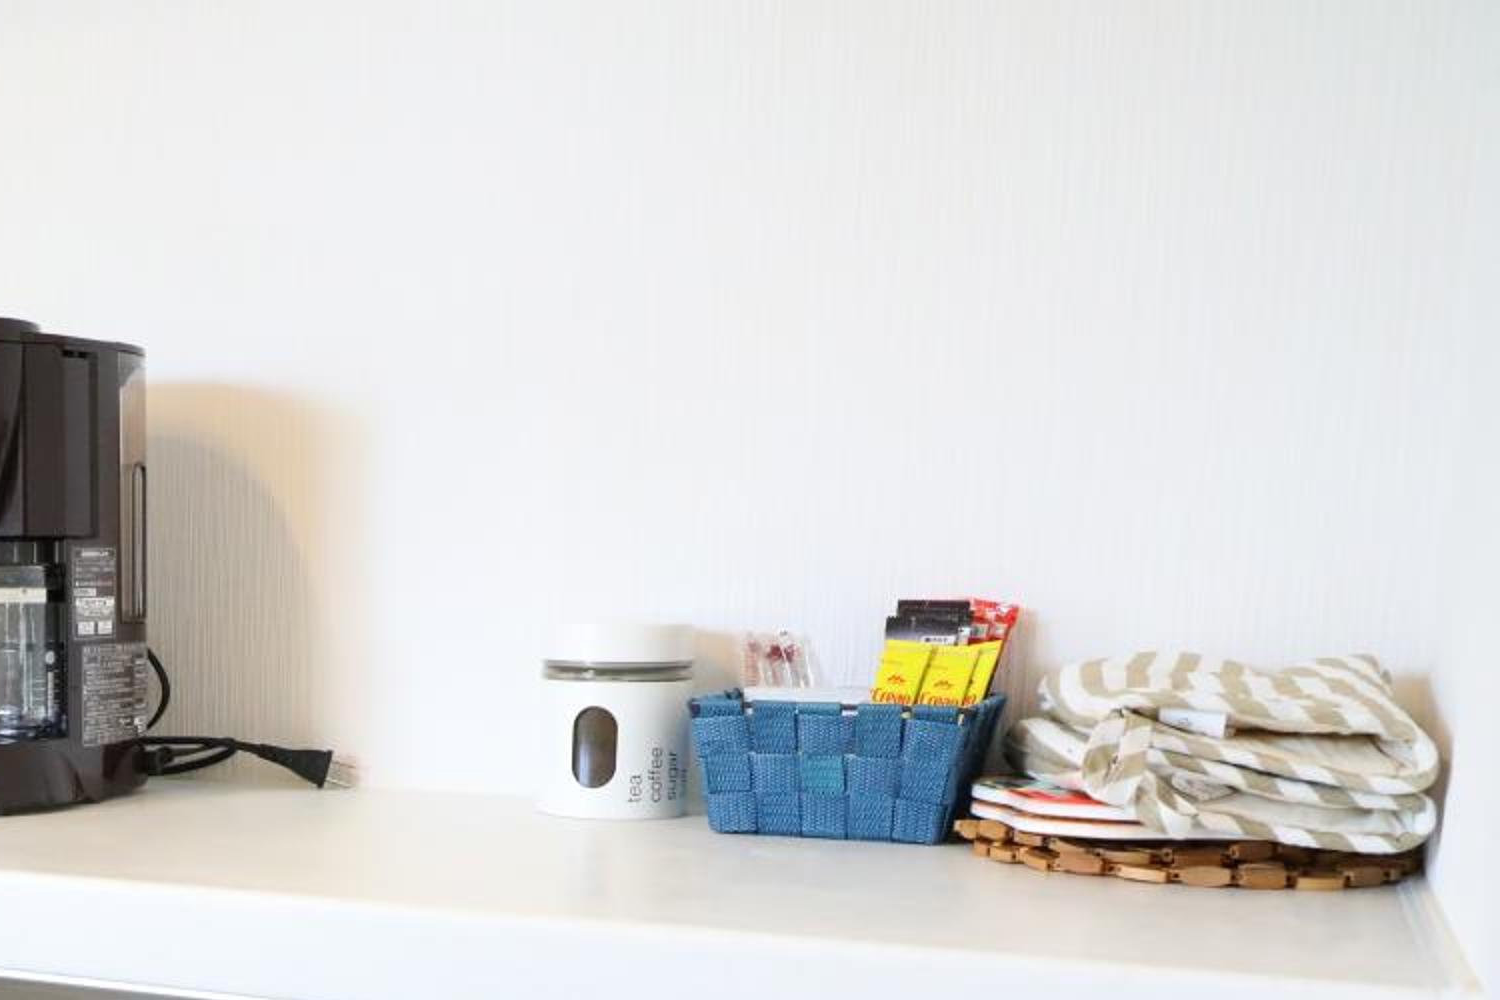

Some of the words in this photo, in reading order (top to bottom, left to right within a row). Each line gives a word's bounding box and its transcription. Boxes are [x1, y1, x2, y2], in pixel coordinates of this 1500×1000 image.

[628, 775, 643, 802] tea
[647, 747, 663, 803] coffee
[667, 752, 680, 801] sugar
